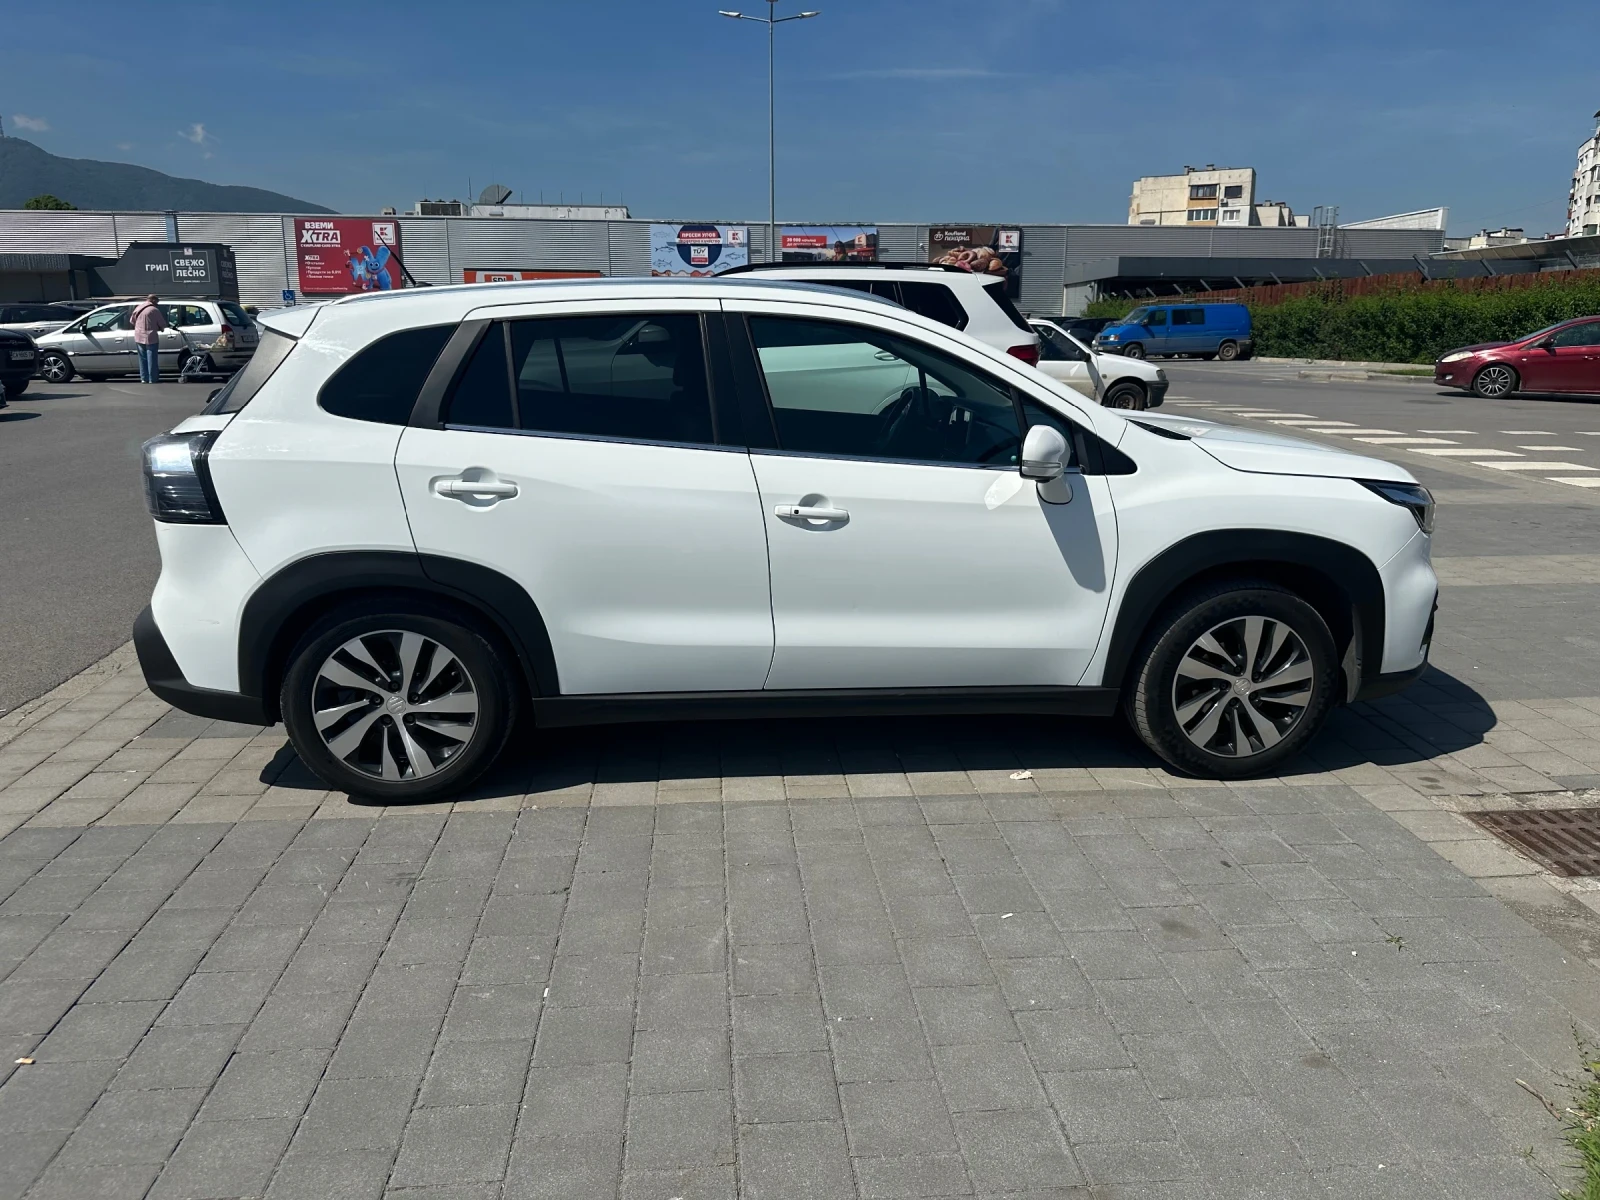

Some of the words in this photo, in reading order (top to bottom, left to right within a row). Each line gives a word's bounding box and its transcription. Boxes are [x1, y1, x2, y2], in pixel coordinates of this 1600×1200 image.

[301, 229, 340, 243] XTRA
[174, 259, 205, 267] СВЕЖО
[176, 269, 206, 277] ЛЕСНО
